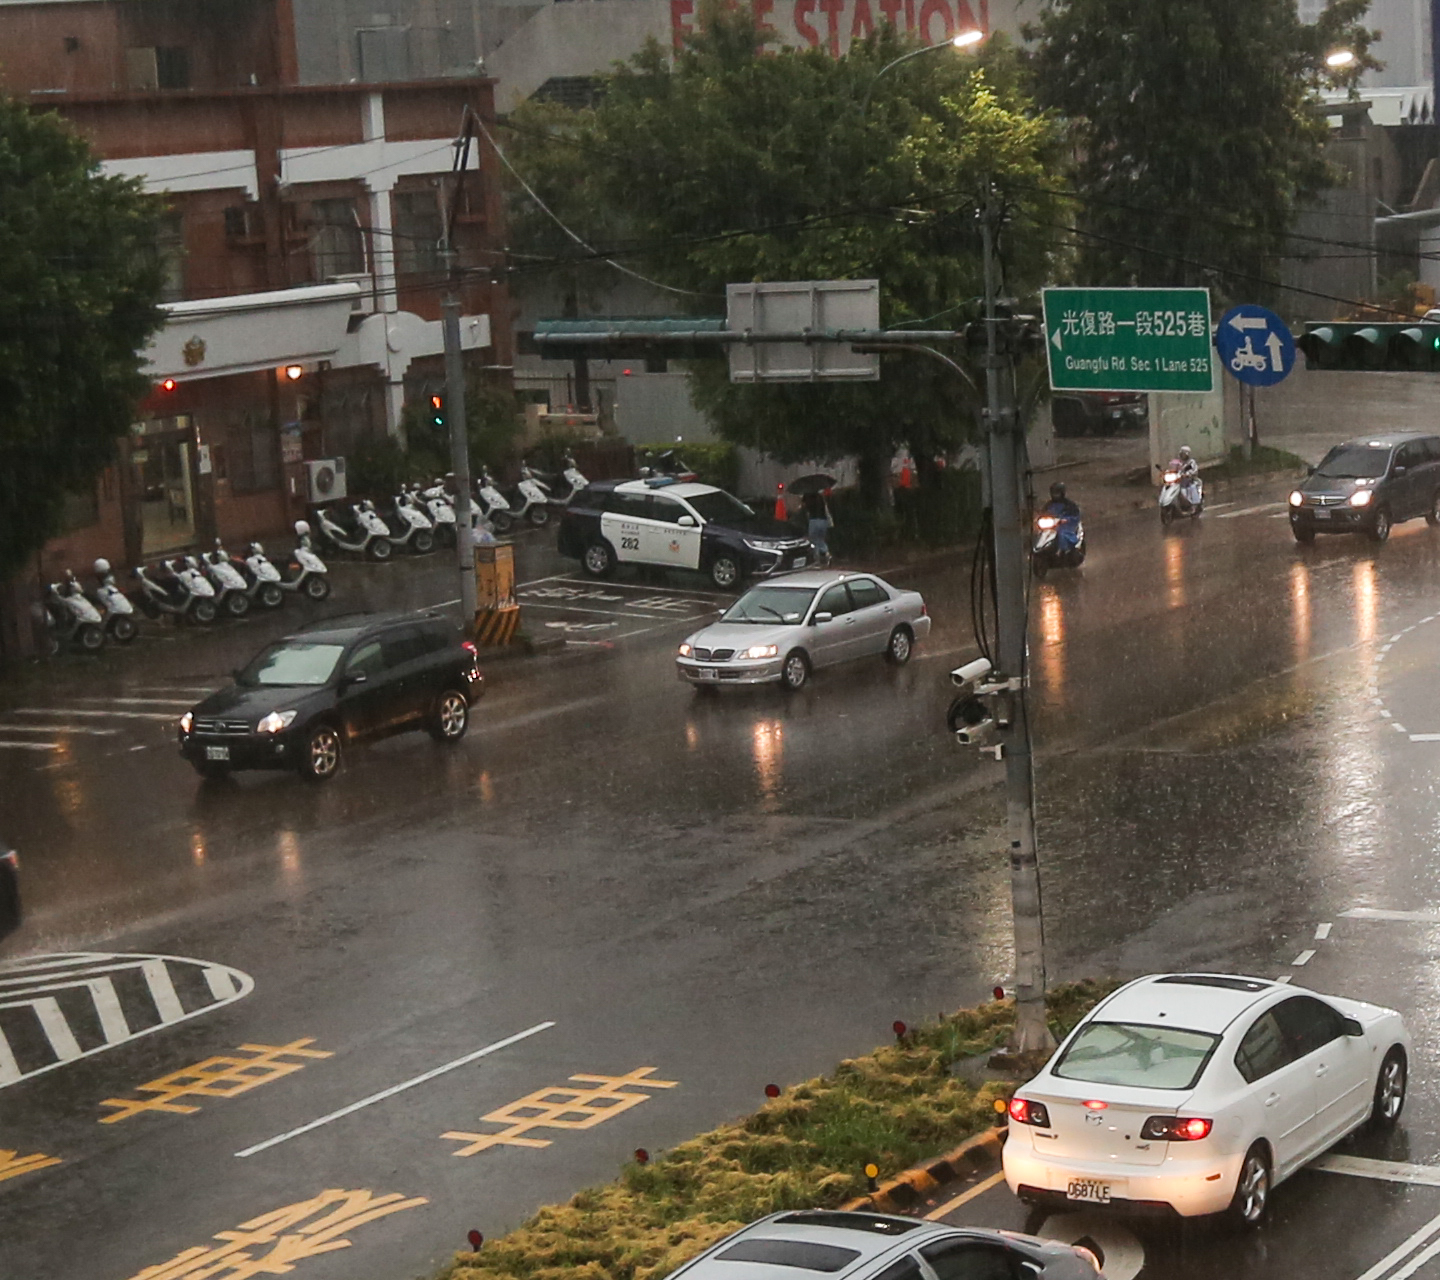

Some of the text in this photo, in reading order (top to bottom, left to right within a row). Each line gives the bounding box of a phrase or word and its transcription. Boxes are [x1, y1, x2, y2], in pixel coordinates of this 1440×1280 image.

[1061, 309, 1207, 338] 光復路一段525巷
[1065, 356, 1109, 375] Guangfu
[1111, 356, 1128, 372] Rd.
[1130, 356, 1153, 372] Sec.
[1162, 357, 1188, 373] Lane
[1189, 357, 1209, 373] 525
[621, 537, 639, 550] 282
